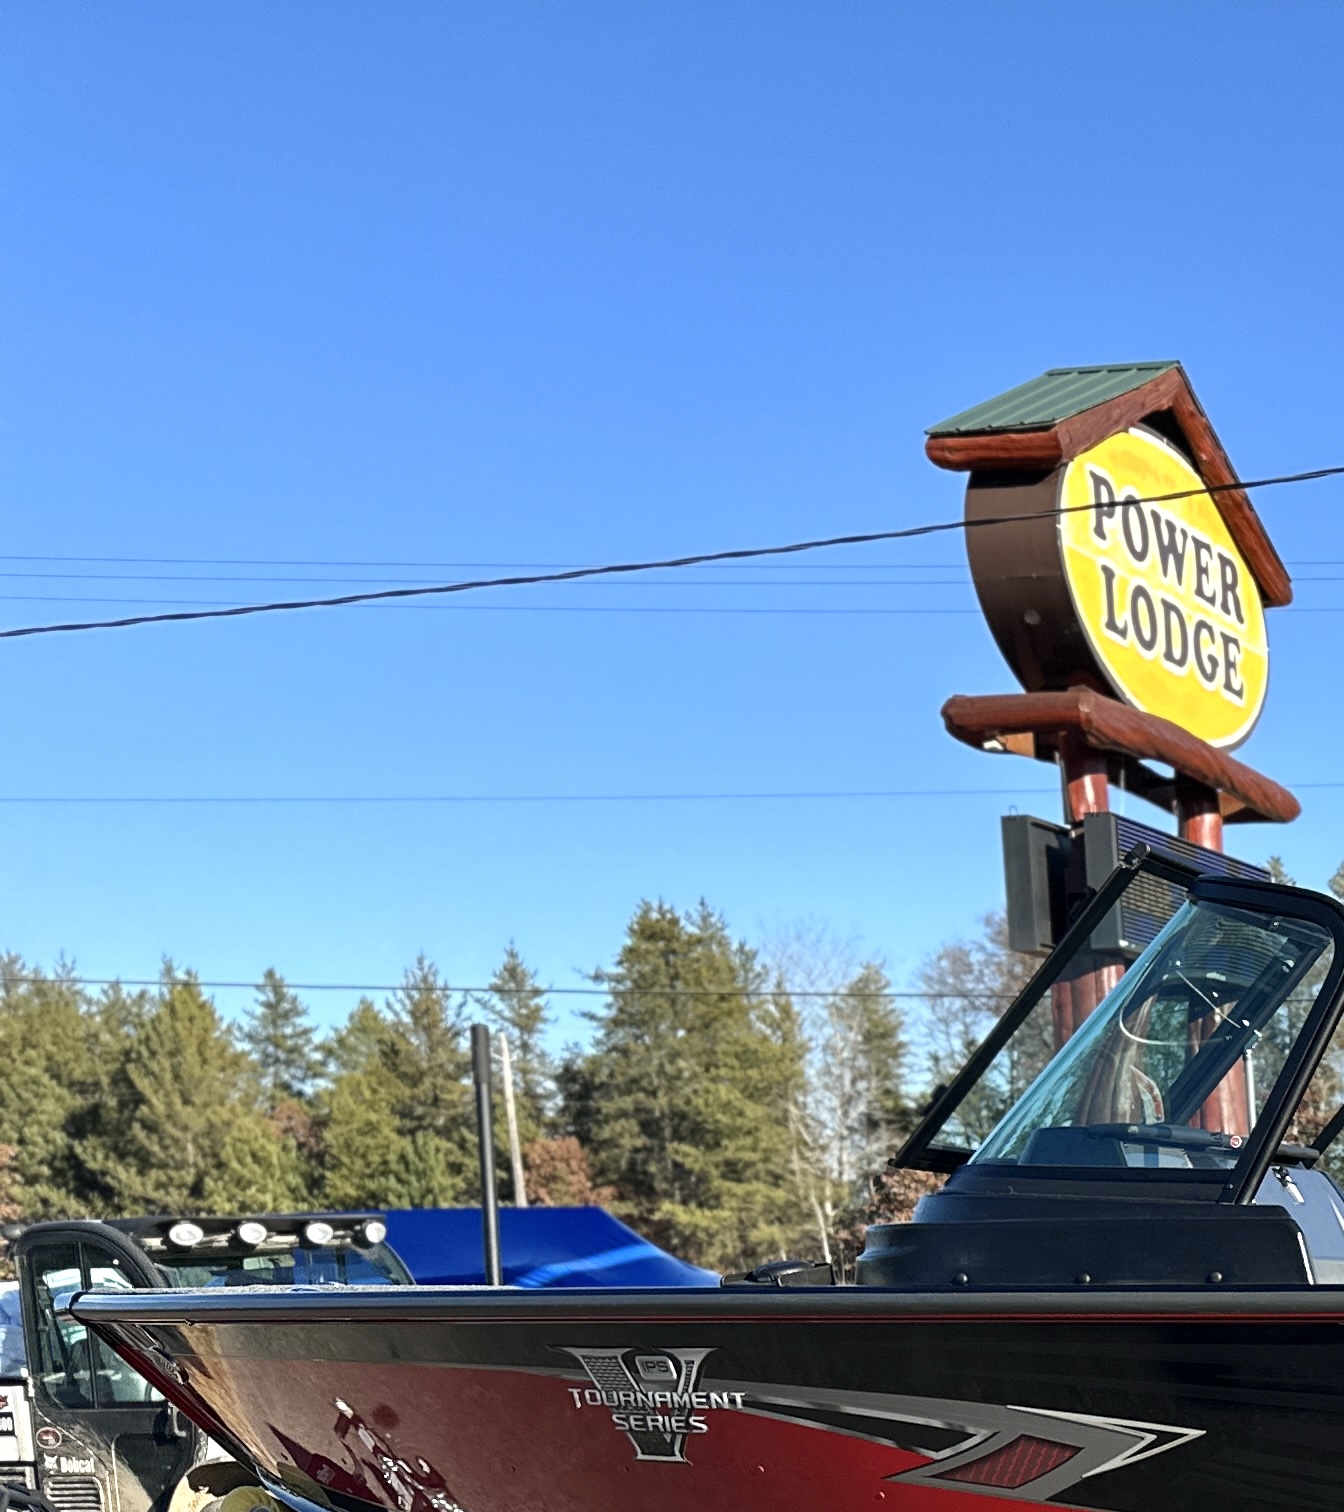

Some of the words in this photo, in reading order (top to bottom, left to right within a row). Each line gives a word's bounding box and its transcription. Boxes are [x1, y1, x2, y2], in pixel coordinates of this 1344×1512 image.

[1089, 470, 1245, 625] POWER
[1101, 564, 1244, 701] LODGE
[567, 1387, 748, 1410] TOURNAMENT
[611, 1413, 709, 1434] SERIES
[59, 1456, 96, 1474] Bobcat
